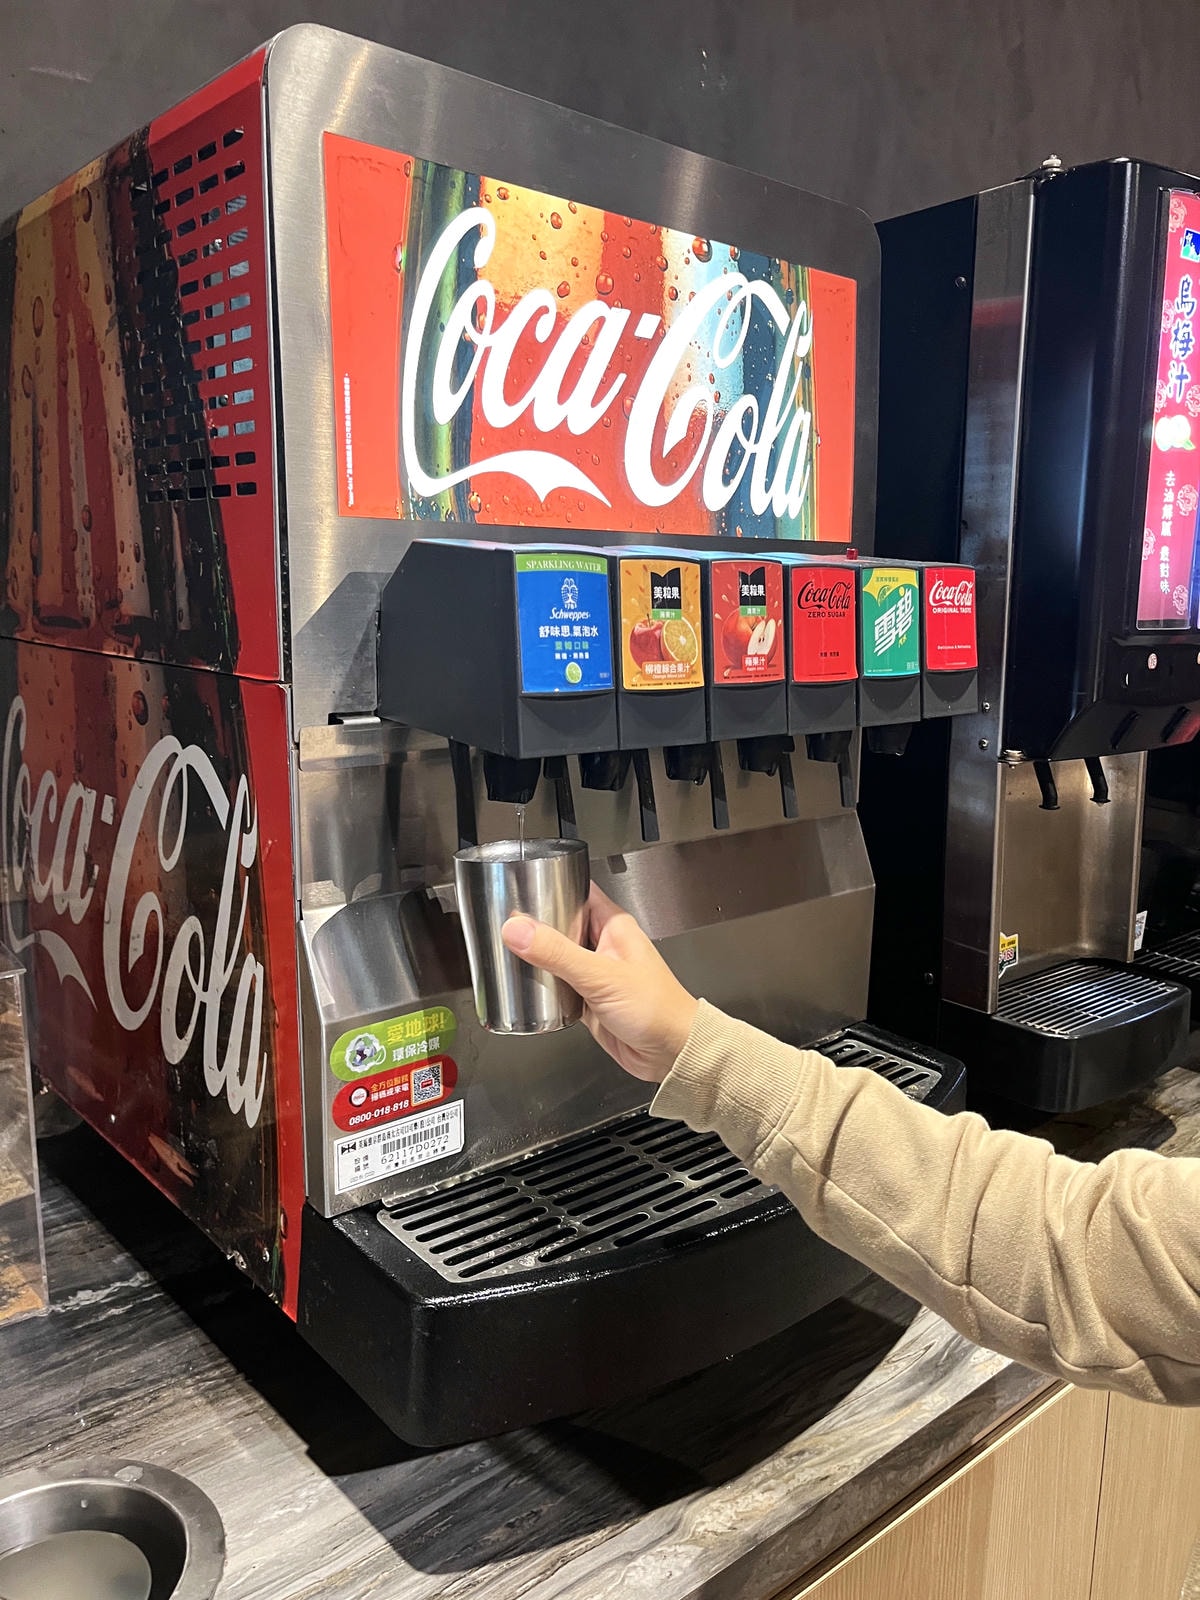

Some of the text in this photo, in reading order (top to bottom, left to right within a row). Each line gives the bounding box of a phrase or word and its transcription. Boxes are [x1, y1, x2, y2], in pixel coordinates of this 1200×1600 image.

[402, 206, 813, 520] Coca-Cola
[526, 559, 602, 572] SPARKLING WATER
[653, 586, 680, 600] 美粒果
[741, 584, 765, 597] 美粒果
[798, 580, 852, 610] Coca-Cola
[929, 580, 974, 607] Coca-Cola
[549, 607, 590, 621] Schweppes
[873, 588, 915, 657] 雪碧
[0, 694, 268, 1129] Coca-Cola
[392, 1036, 440, 1062] 環保冷媒
[380, 1134, 450, 1165] 62117D0272
